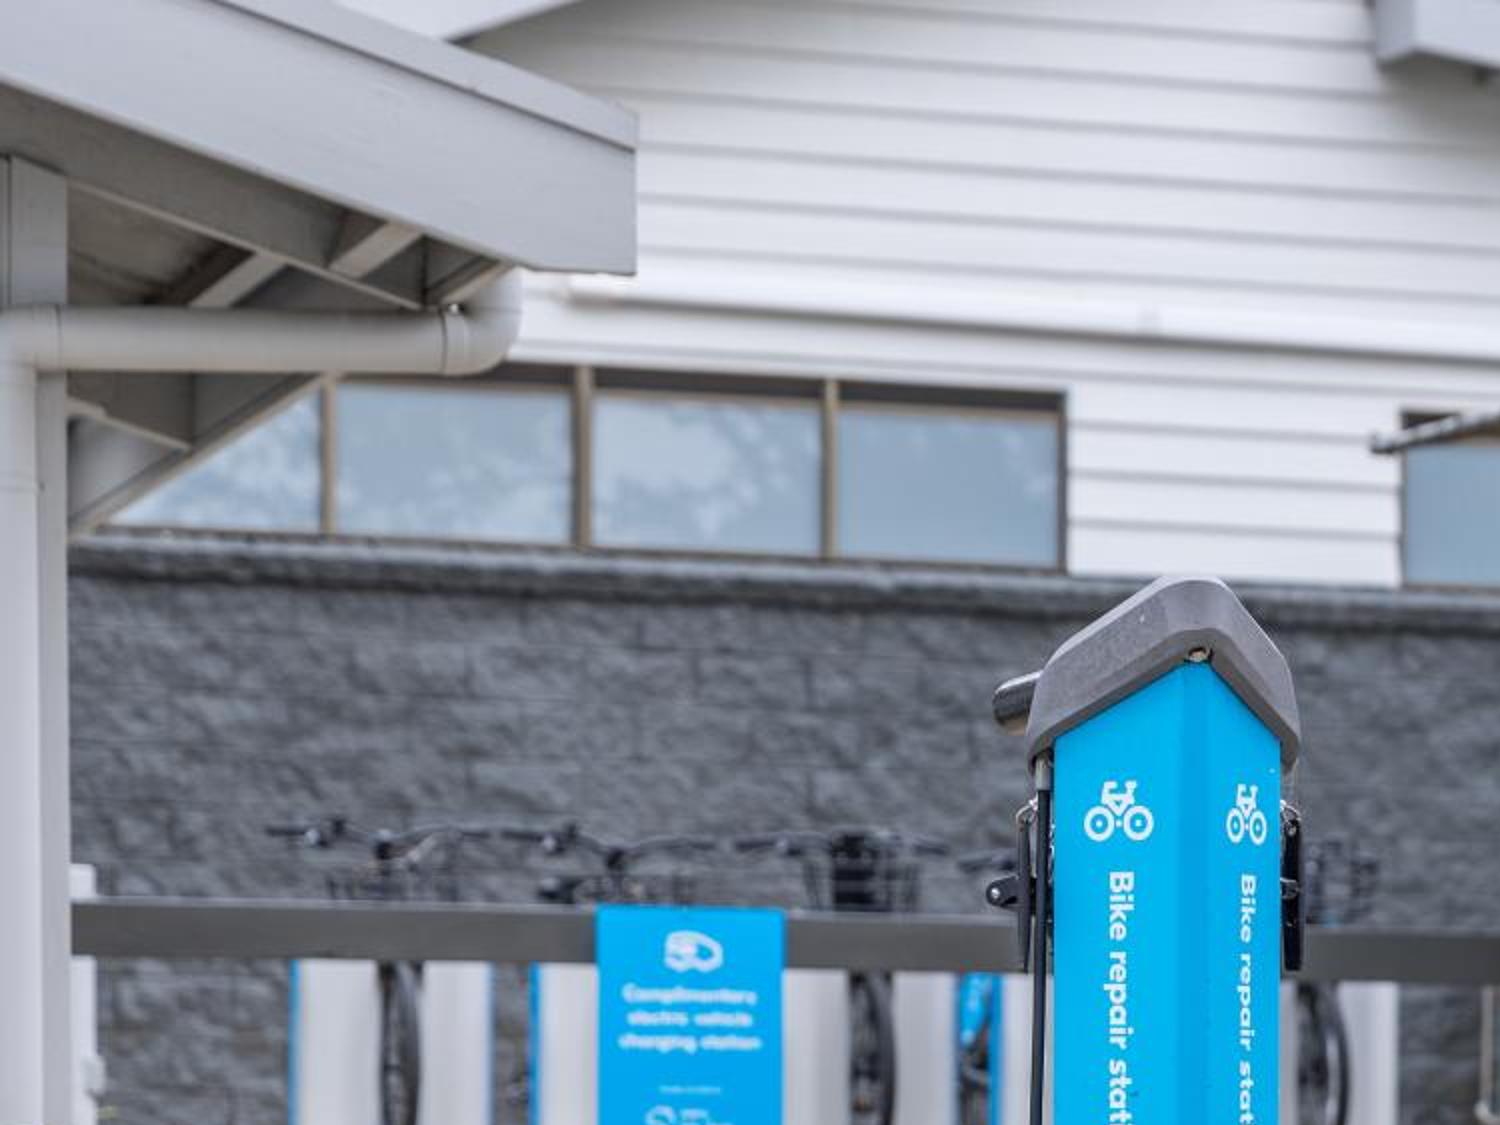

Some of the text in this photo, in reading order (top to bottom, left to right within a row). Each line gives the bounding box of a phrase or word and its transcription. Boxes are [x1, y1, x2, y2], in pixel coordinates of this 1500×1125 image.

[1108, 871, 1135, 941] Bike
[1239, 874, 1257, 943] Bike
[1103, 951, 1135, 1049] repair
[1236, 953, 1255, 1050] repair
